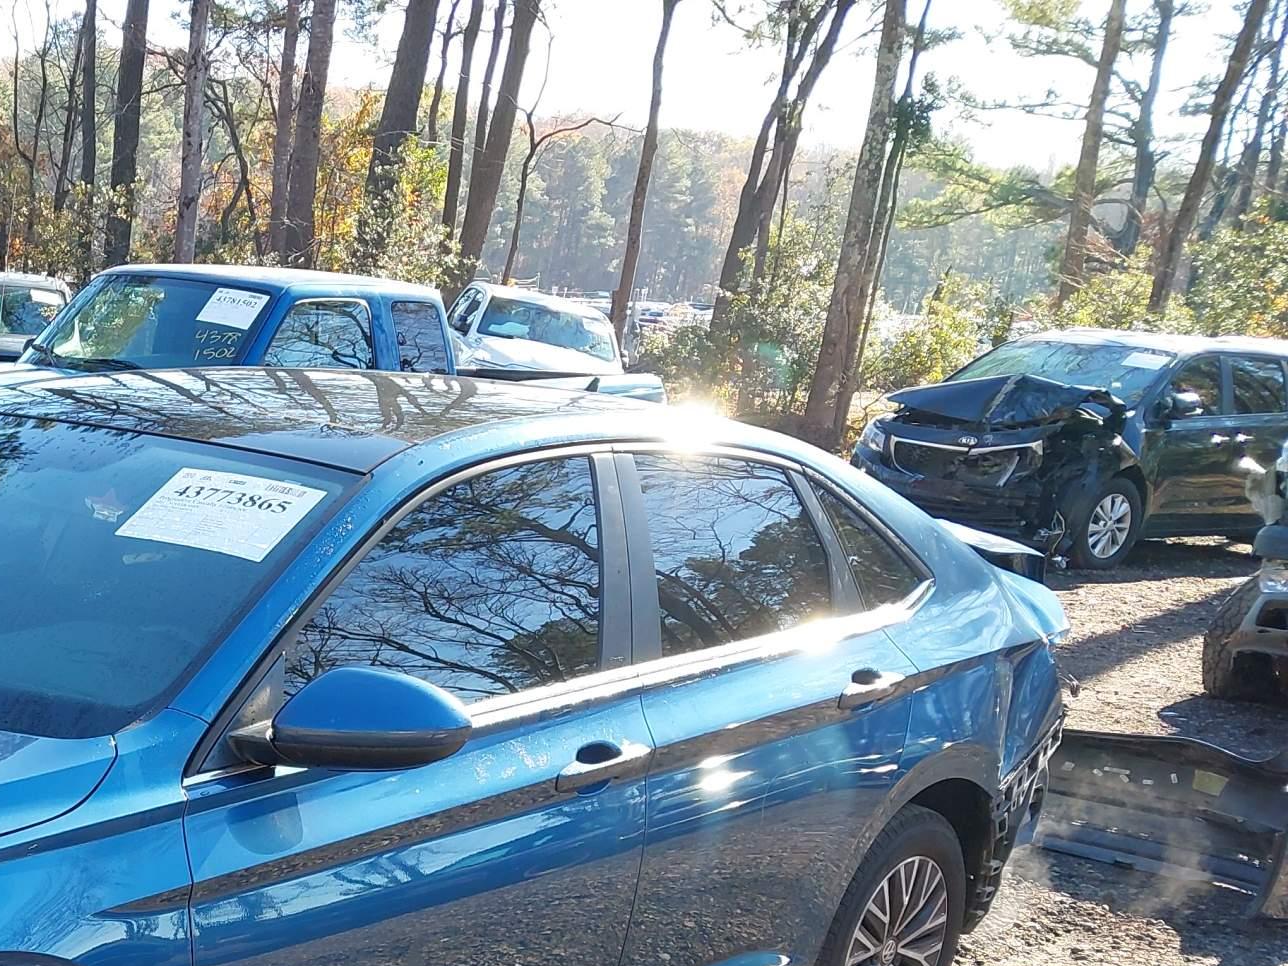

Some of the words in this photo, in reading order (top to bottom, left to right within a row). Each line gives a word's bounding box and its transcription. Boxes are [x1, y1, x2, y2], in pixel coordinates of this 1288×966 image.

[195, 329, 242, 345] 4378
[194, 346, 236, 360] 1502
[174, 484, 293, 514] 43773865
